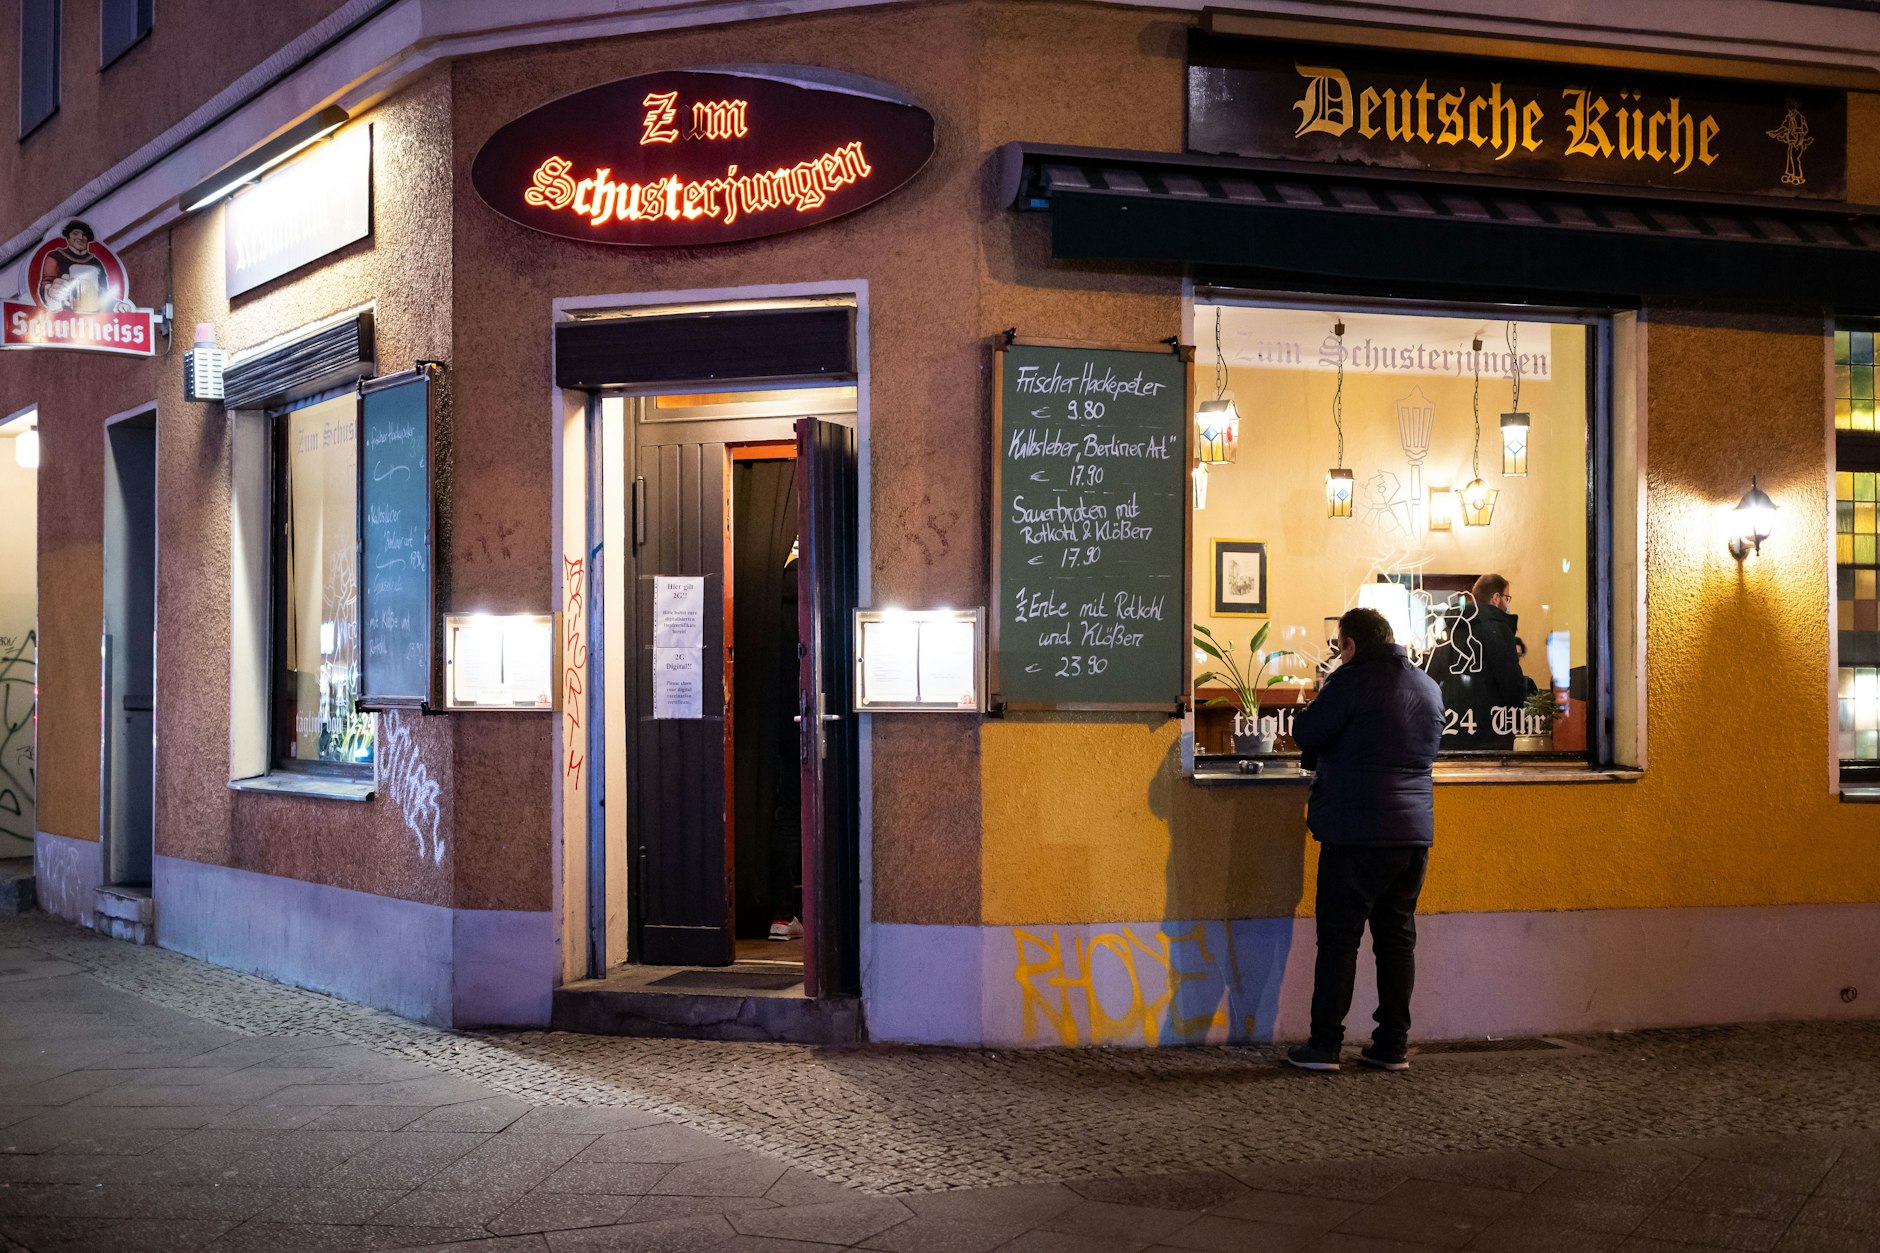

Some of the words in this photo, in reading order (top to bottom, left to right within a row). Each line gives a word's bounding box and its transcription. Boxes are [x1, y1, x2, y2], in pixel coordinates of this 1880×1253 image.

[639, 90, 748, 146] Zum
[1292, 59, 1544, 161] Deutsche
[1563, 84, 1721, 175] Küche
[523, 140, 873, 226] Schusterjungen
[12, 311, 144, 344] Schultheiss
[1233, 331, 1302, 365] Zum
[1318, 330, 1549, 379] Schusterjungen
[1016, 362, 1079, 395] Frischer
[1079, 361, 1166, 401] Hackepeter
[1068, 400, 1105, 420] 9.80
[1008, 428, 1078, 460] Kalbsleber
[1069, 464, 1104, 486] 17.90
[1012, 494, 1107, 525] Sauerbraten
[1115, 491, 1141, 519] mit
[1020, 522, 1079, 545] Rotkohl
[1082, 520, 1092, 542] &
[1095, 520, 1153, 542] Klößen
[1061, 546, 1102, 568] 17.90
[1029, 589, 1069, 619] Ente
[1079, 592, 1109, 618] mit
[1114, 591, 1165, 621] Rotkohl
[1038, 621, 1072, 647] und
[1080, 620, 1144, 648] Klößen
[1233, 708, 1295, 742] tägli
[1490, 705, 1547, 738] Uhr
